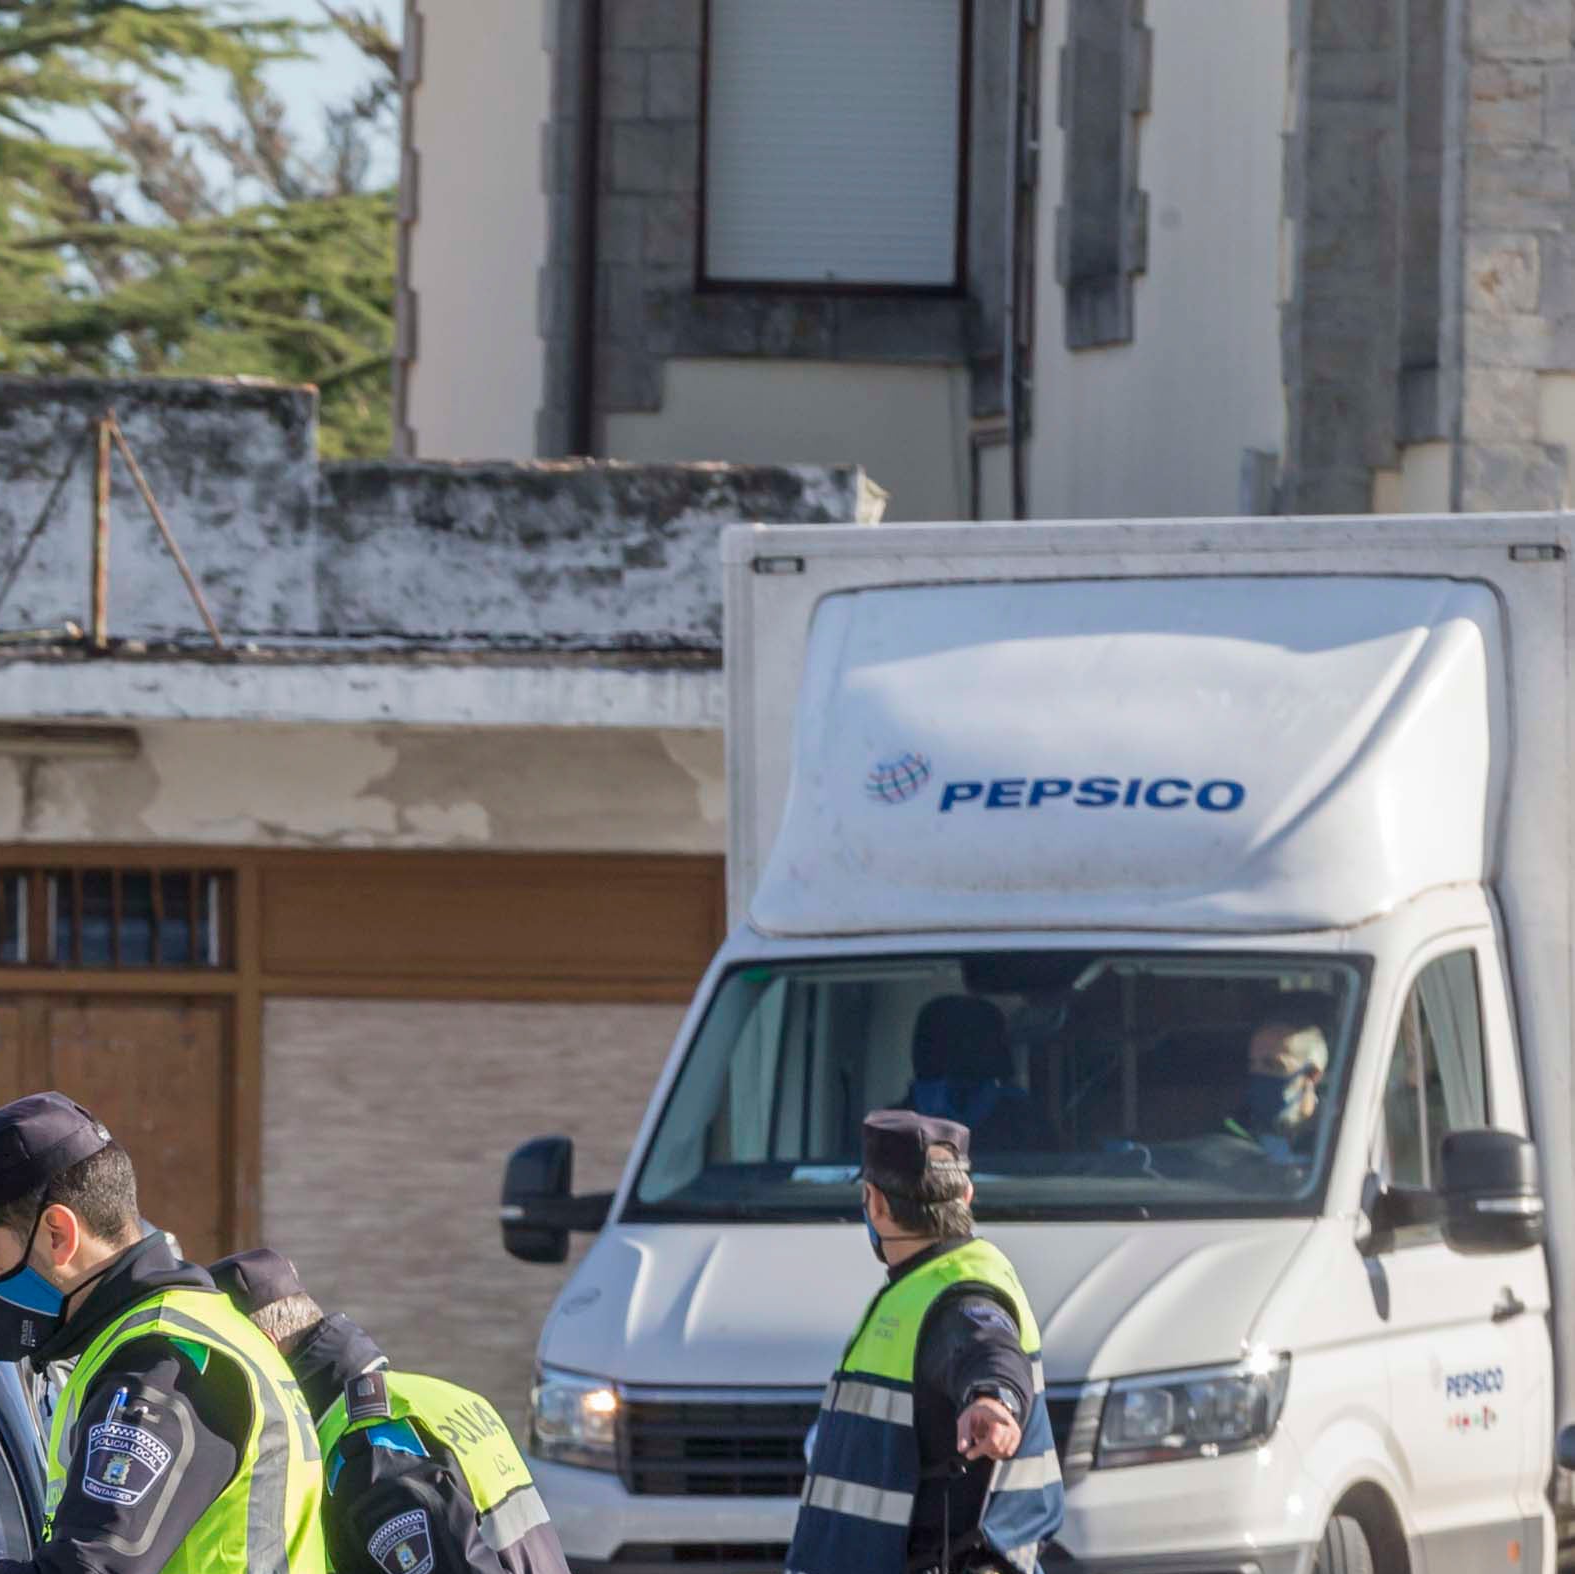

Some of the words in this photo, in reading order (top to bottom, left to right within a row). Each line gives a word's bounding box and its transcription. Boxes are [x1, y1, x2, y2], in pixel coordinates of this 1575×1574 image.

[939, 777, 1245, 813] PEPSICO
[1446, 1367, 1504, 1398] PEPSICO
[130, 1444, 157, 1467] LOCAL
